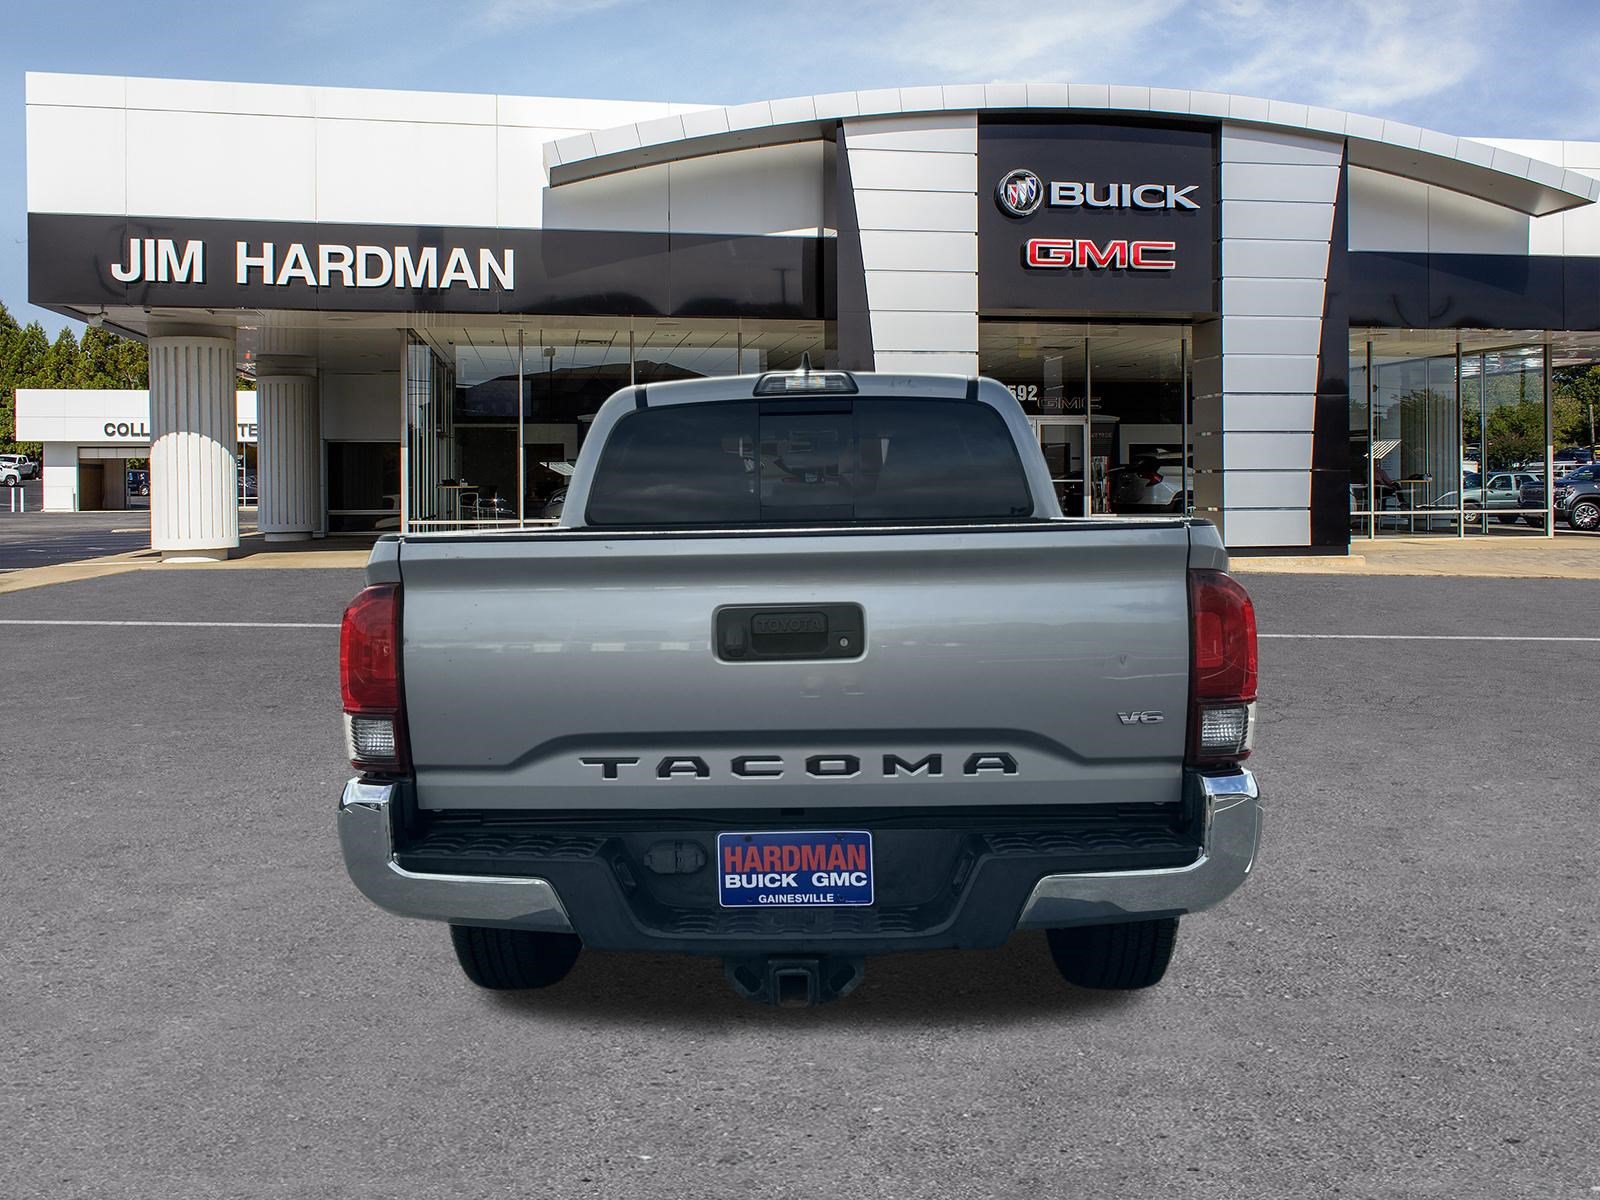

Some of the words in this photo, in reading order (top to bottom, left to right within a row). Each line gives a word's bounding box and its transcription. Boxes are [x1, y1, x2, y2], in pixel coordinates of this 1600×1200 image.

[1051, 181, 1200, 209] BUICK
[111, 238, 203, 283] JIM
[236, 241, 514, 290] HARDMAN
[1026, 238, 1176, 270] GMC
[758, 616, 825, 632] TOYOTA
[1117, 711, 1164, 724] V6
[579, 753, 1019, 780] TACOMA
[724, 844, 867, 873] HARDMAN
[725, 873, 798, 889] BUICK
[811, 872, 867, 887] GMC
[758, 894, 834, 904] GAINESVILLE
